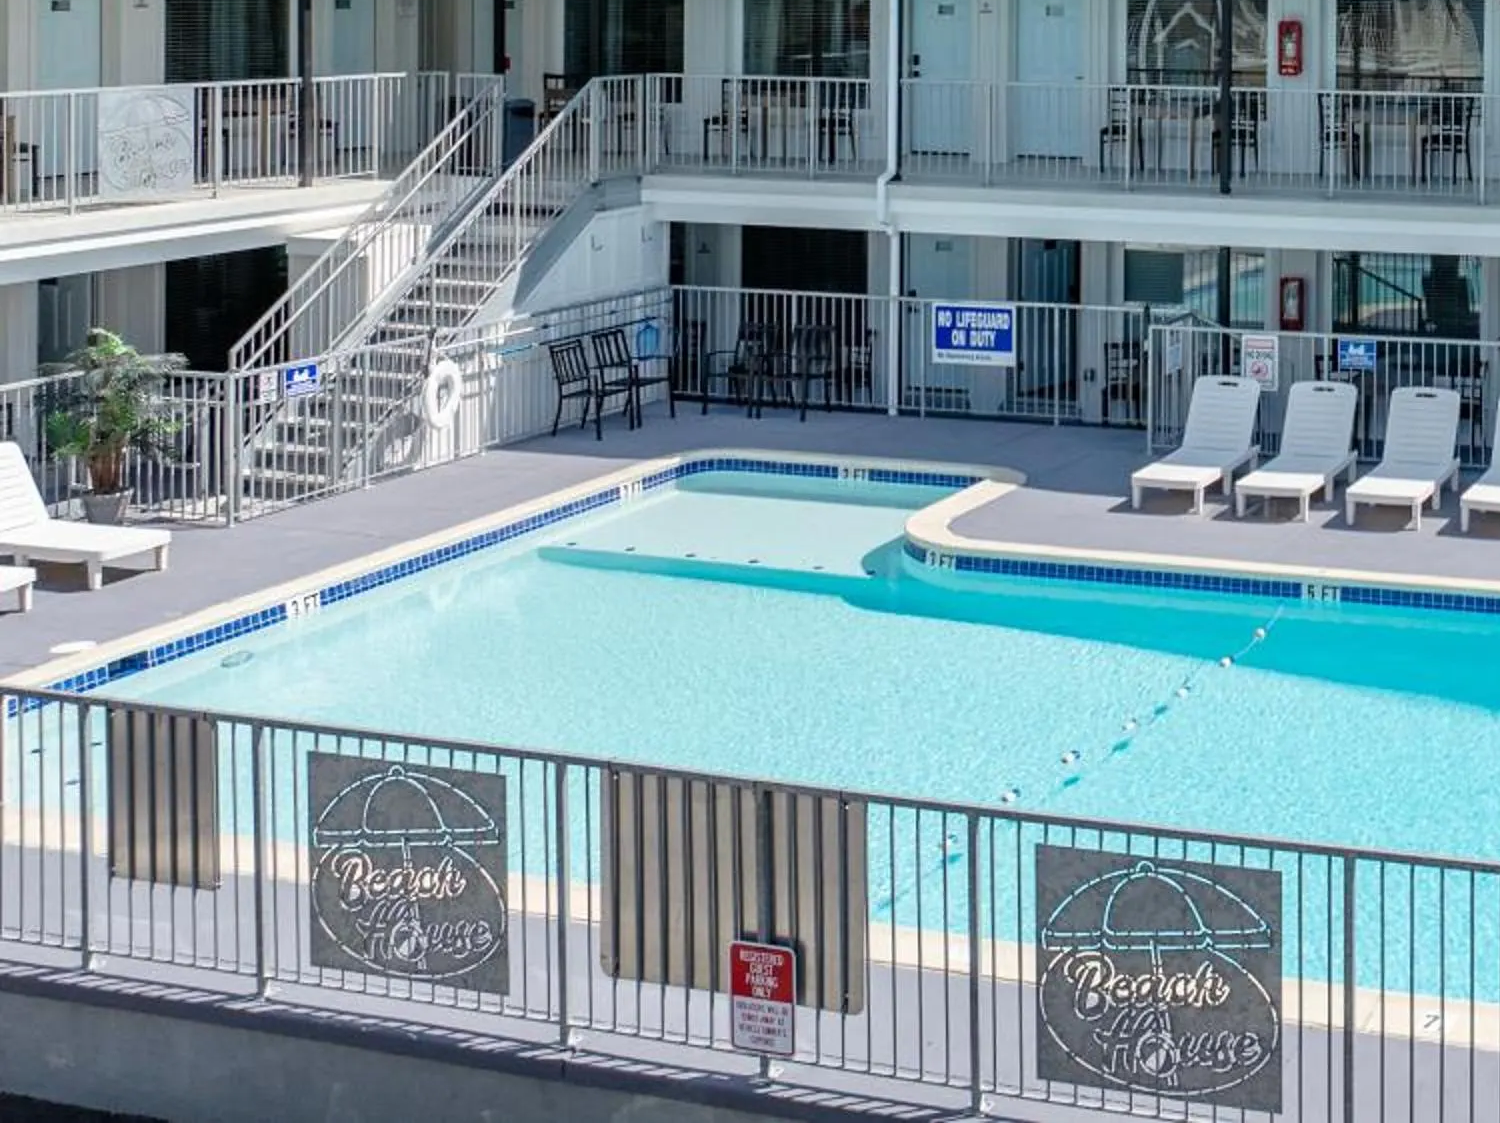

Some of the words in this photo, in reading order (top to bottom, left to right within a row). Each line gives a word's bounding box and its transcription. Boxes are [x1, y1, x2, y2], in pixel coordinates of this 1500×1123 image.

[937, 310, 953, 327] NO
[955, 310, 1011, 330] LIFEGUARD
[951, 329, 967, 346] ON
[969, 330, 997, 348] DUTY
[1321, 584, 1338, 601] FT
[303, 592, 319, 614] FT
[331, 848, 467, 912] Beach
[355, 898, 493, 962] House
[740, 949, 784, 966] REGISTERED
[749, 962, 774, 976] GUEST
[745, 973, 778, 988] PARKING
[1063, 951, 1231, 1021] Beach
[752, 986, 771, 999] ONLY
[1093, 1007, 1262, 1078] House
